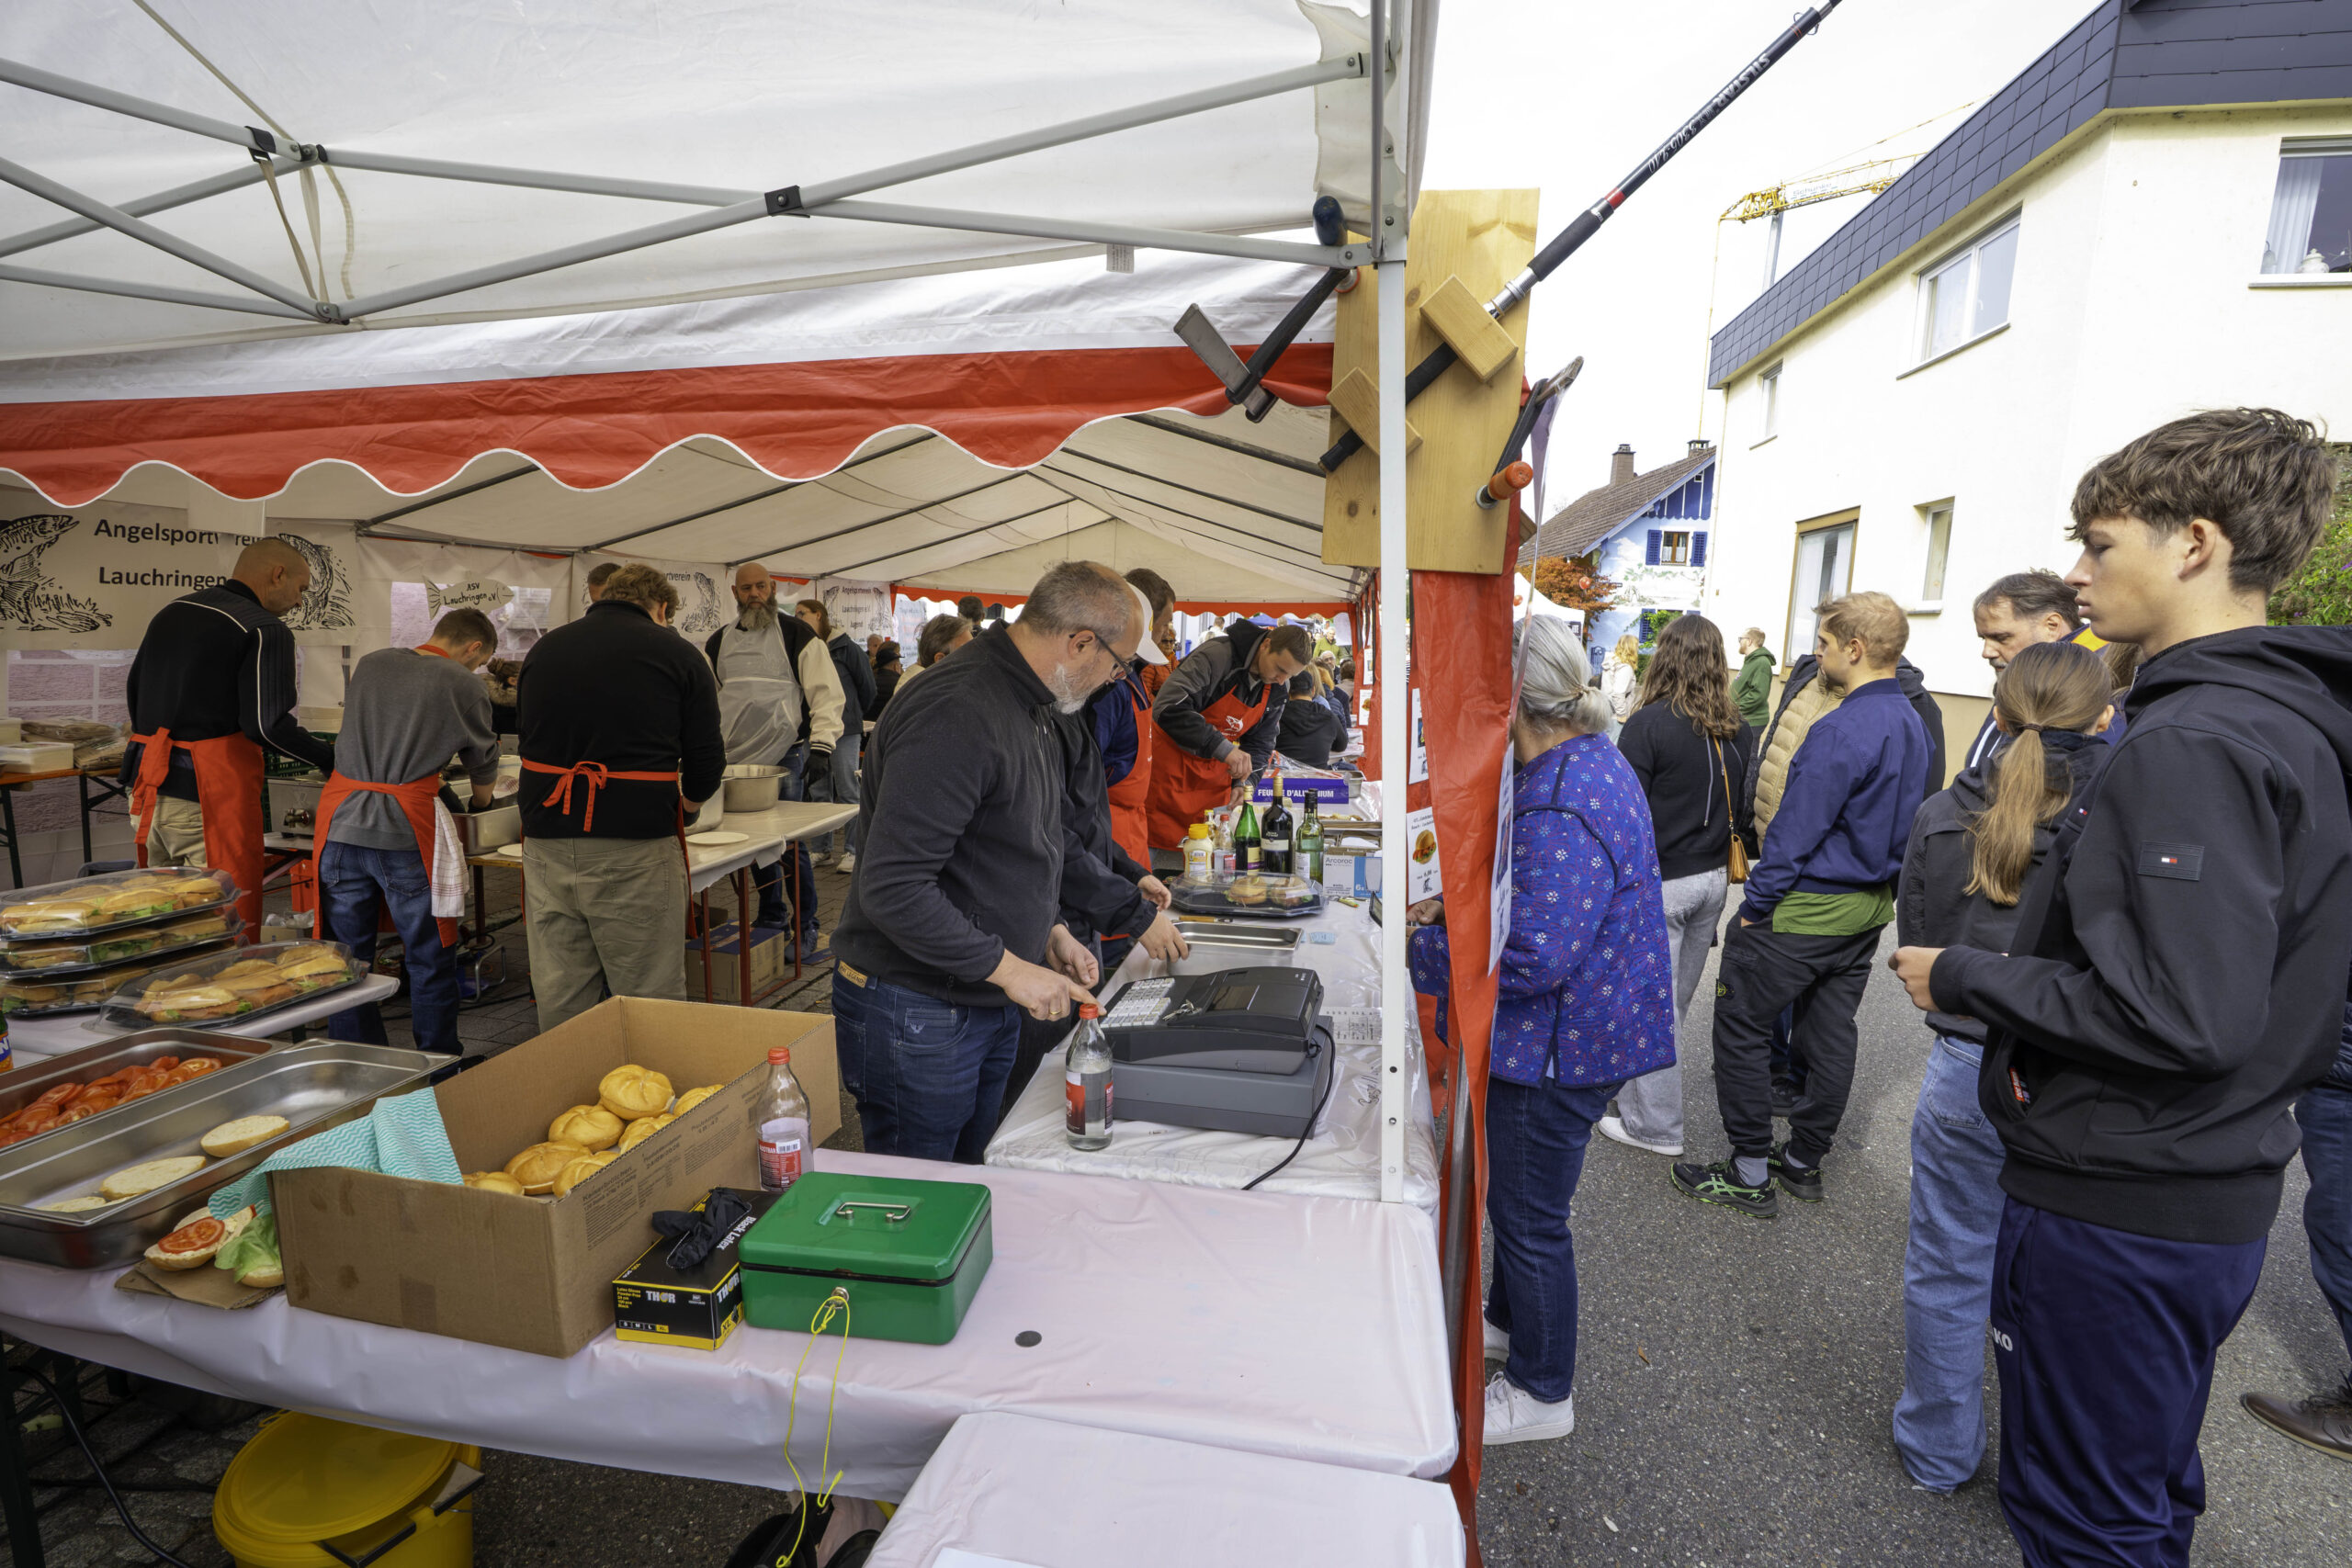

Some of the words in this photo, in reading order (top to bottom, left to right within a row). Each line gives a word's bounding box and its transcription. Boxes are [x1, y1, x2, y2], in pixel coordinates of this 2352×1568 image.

[1712, 53, 1770, 108] SILSTAR
[98, 566, 228, 592] Lauchringen
[1325, 855, 1353, 865] Arcoroc
[733, 1215, 757, 1233] Black
[717, 1231, 741, 1250] Latex
[645, 1290, 676, 1303] THOR
